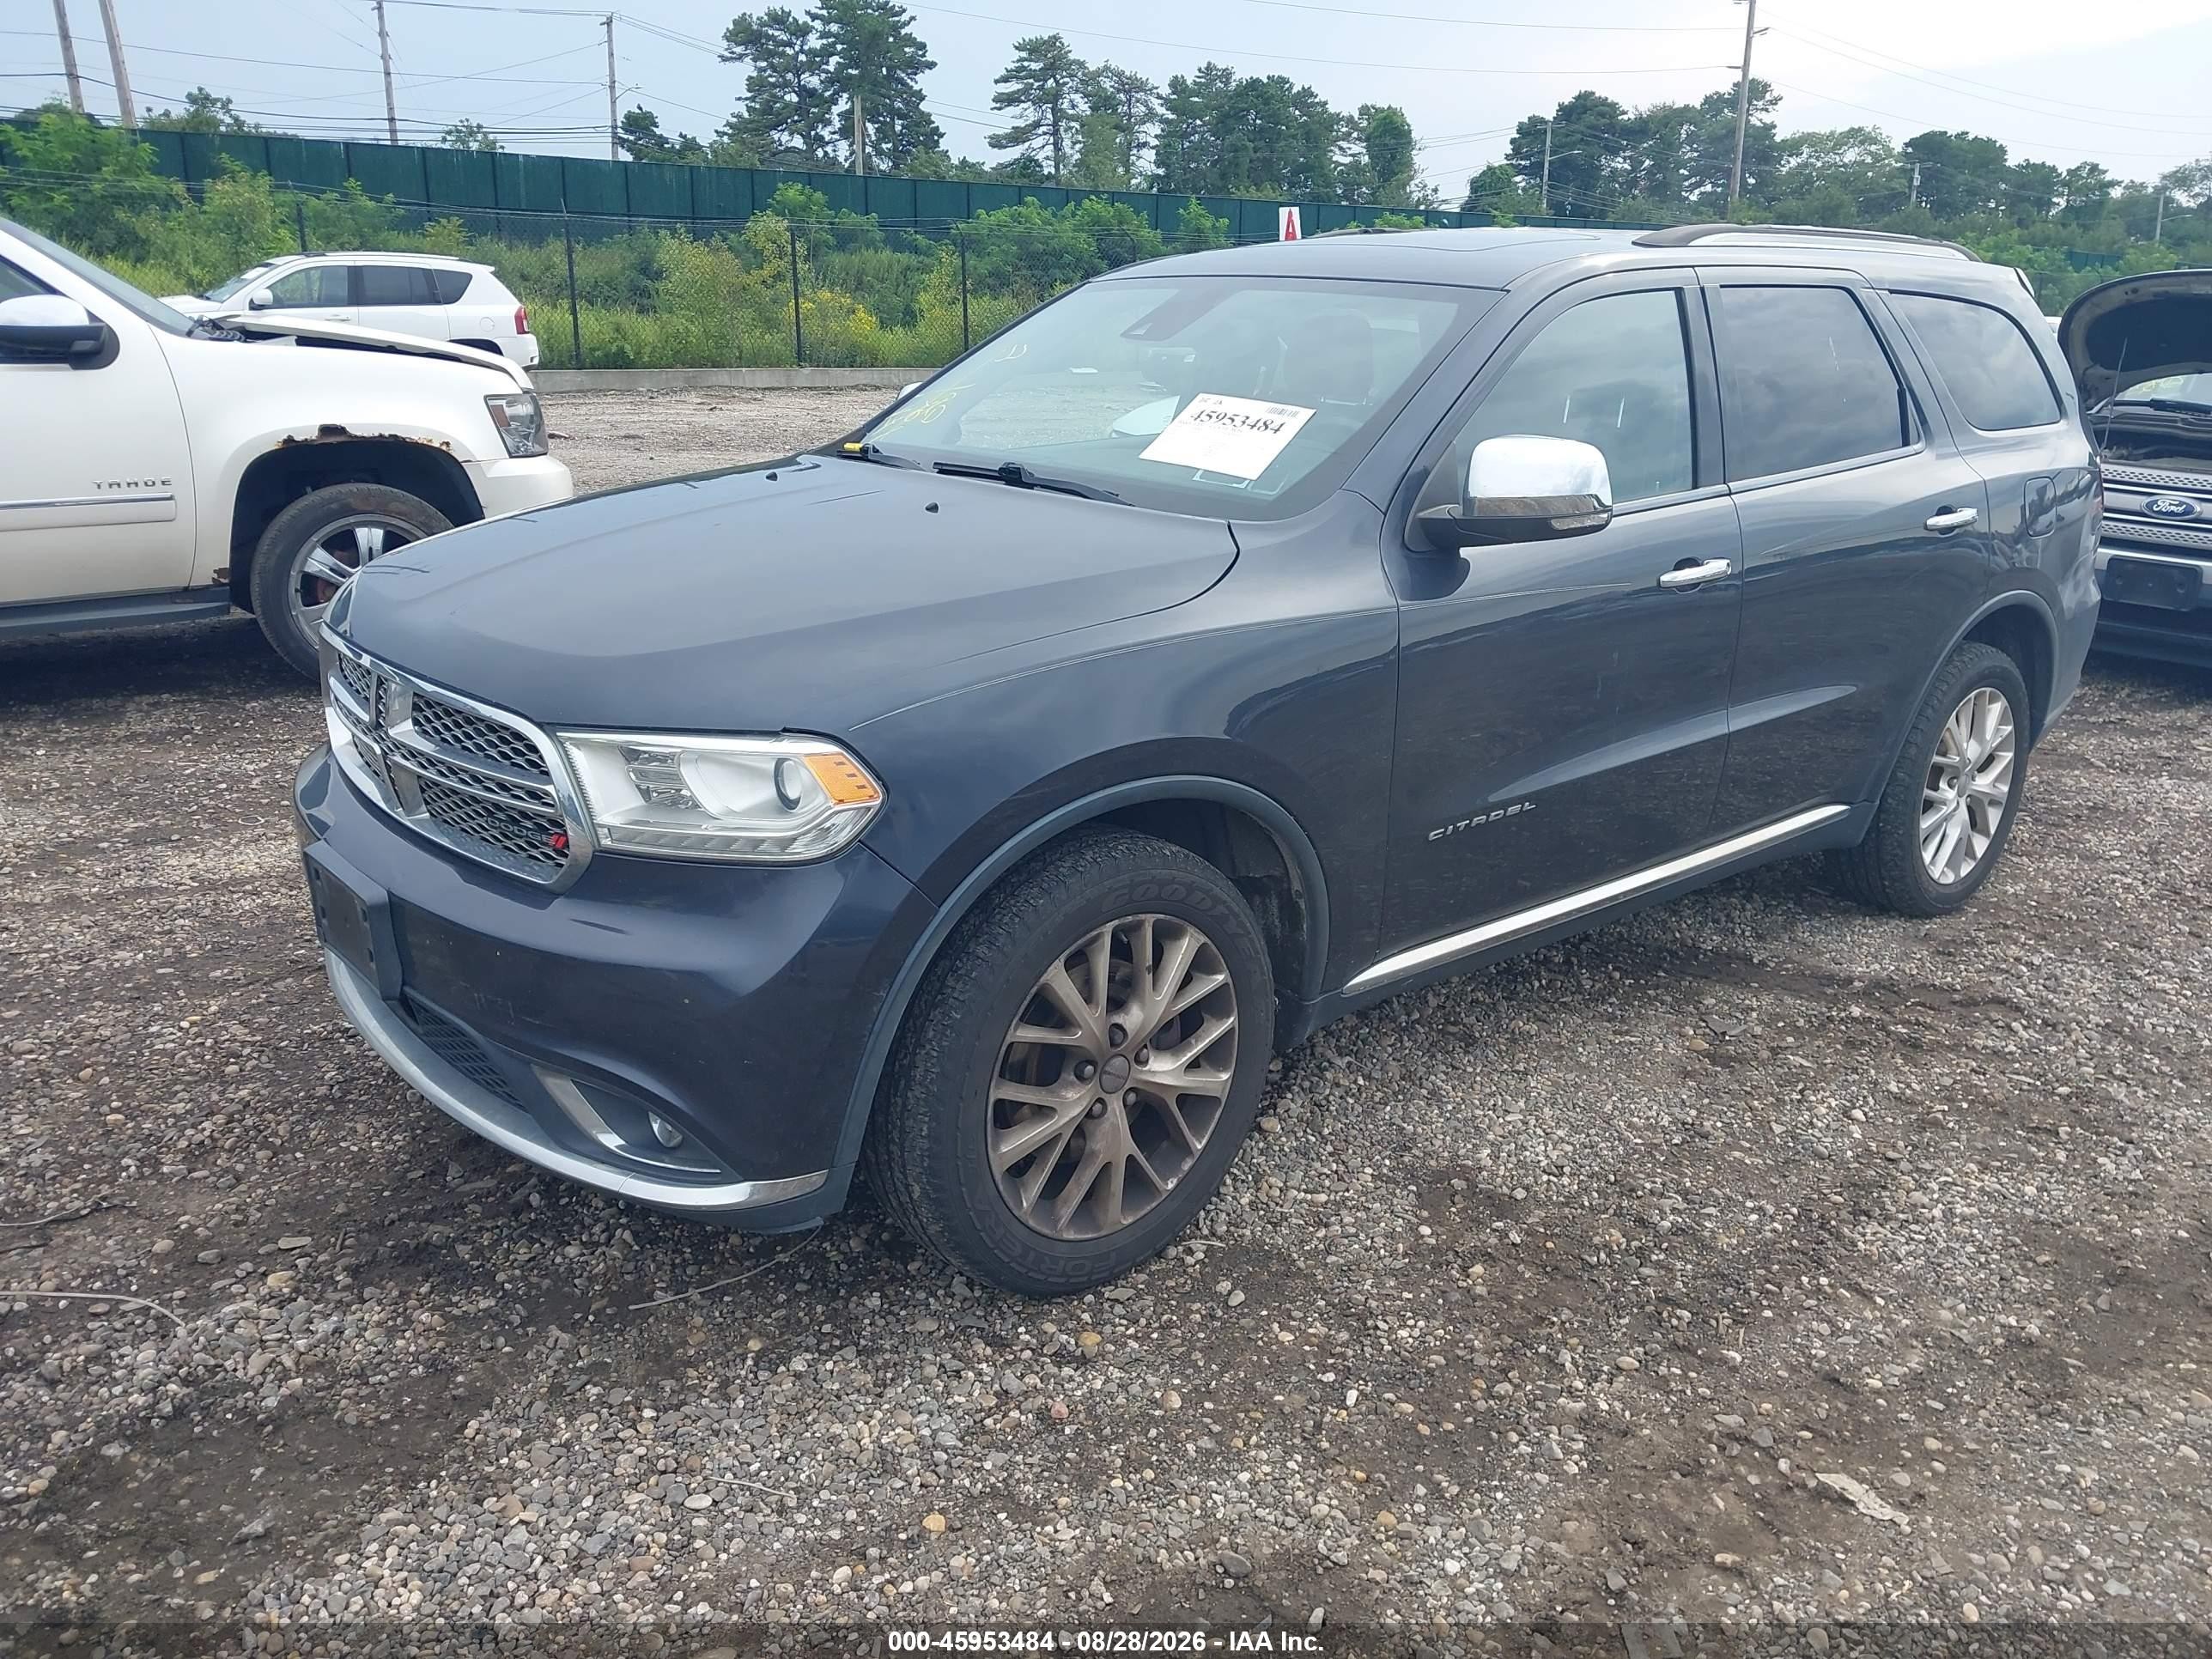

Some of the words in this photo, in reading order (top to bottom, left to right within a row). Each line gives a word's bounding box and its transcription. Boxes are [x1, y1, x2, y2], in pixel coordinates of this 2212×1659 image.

[1190, 409, 1286, 434] 45953484
[92, 477, 173, 490] TAHOE
[2153, 499, 2187, 514] Ford
[487, 817, 555, 846] DODGE
[1428, 801, 1537, 842] CITADEL
